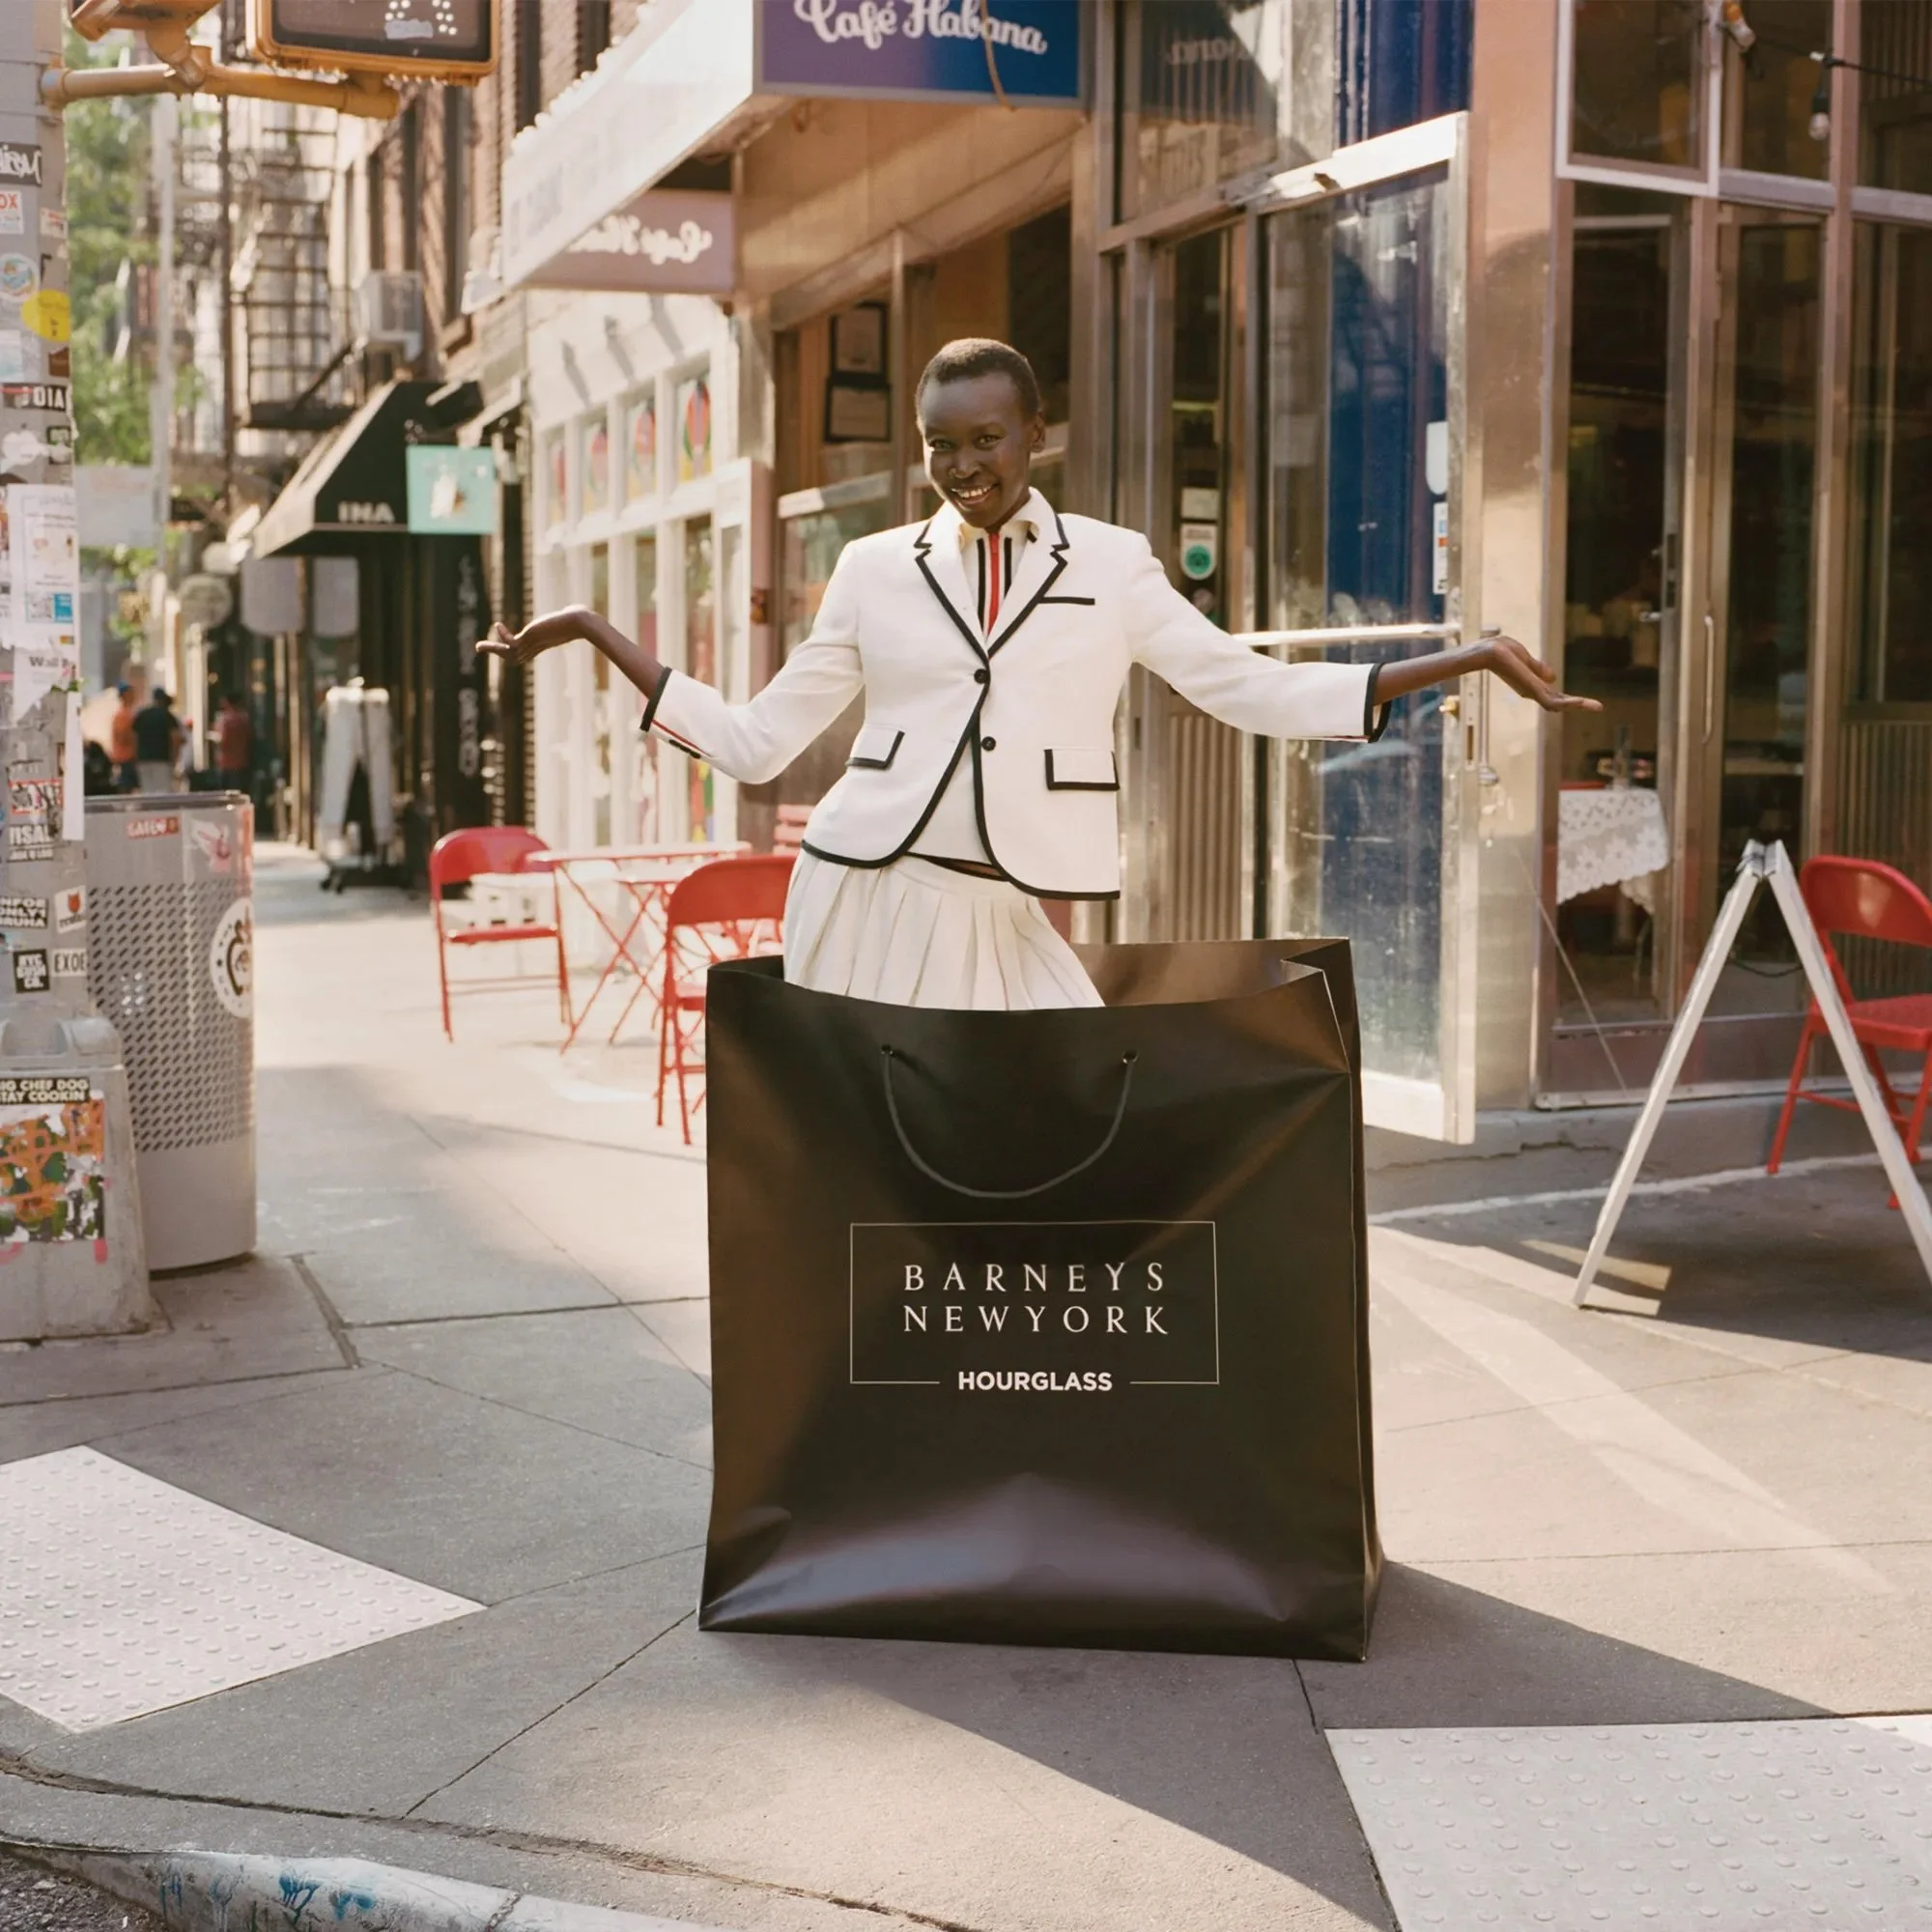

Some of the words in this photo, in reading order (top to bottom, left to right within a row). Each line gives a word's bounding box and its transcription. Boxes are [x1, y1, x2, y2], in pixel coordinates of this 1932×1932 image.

[794, 0, 896, 49] Café
[902, 0, 1048, 55] Habana
[903, 1262, 1165, 1293] BARNEYS
[957, 1371, 1114, 1391] HOURGLASS
